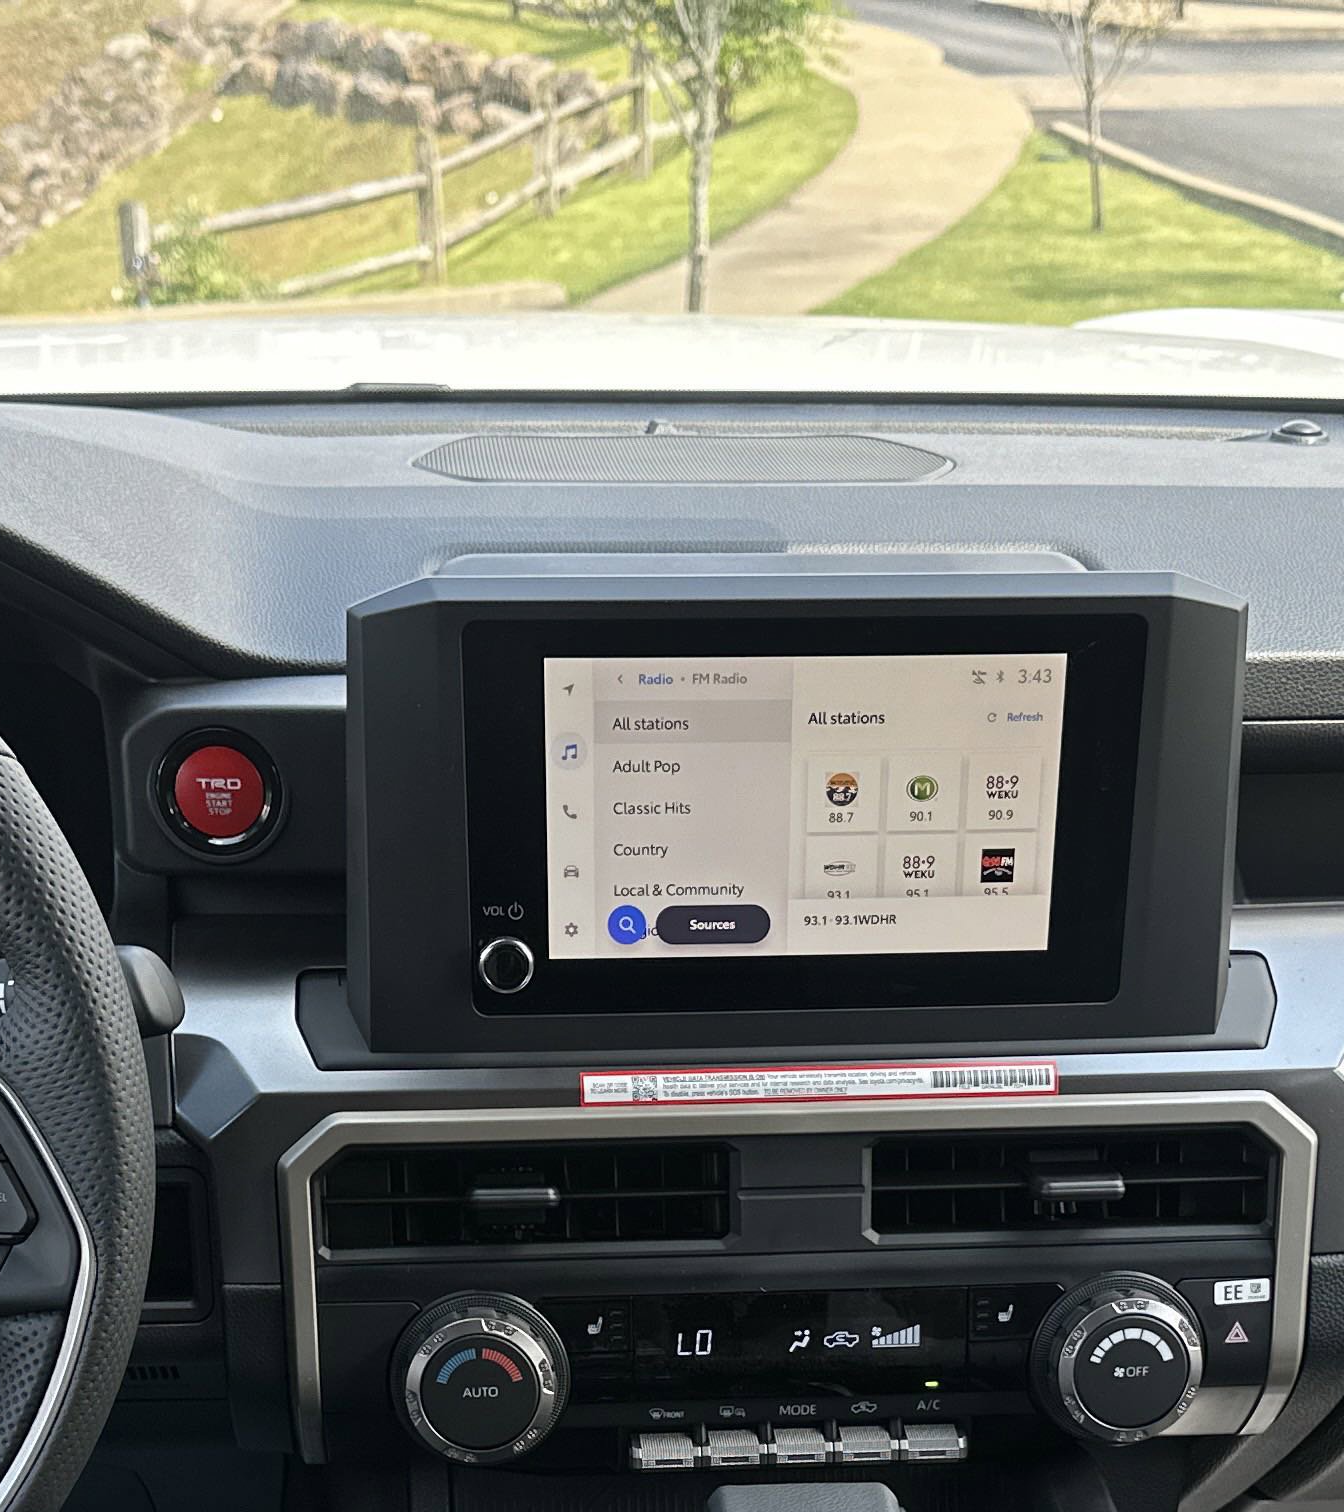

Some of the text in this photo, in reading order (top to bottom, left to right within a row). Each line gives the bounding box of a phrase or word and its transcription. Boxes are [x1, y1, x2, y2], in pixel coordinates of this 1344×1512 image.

[638, 672, 748, 685] Radio FM Radio
[1018, 668, 1053, 684] 3:43
[612, 716, 689, 731] All stations
[807, 711, 885, 725] All stations
[1007, 712, 1044, 723] Refresh
[612, 760, 681, 775] Adult Pop
[196, 778, 241, 790] TRD
[986, 790, 1019, 800] WEKU
[613, 801, 692, 815] Classic Hits
[828, 811, 854, 824] 88.7
[909, 811, 933, 822] 90.1
[988, 810, 1014, 821] 90.9
[613, 843, 668, 859] Country
[902, 869, 936, 879] WEKU
[613, 882, 745, 899] Local & Community
[482, 905, 505, 917] VOL
[689, 919, 736, 931] Sources
[804, 914, 897, 926] 93.1 93.1WDHR
[677, 1330, 713, 1357] LO
[1126, 1365, 1150, 1378] OFF
[463, 1386, 499, 1399] AUTO
[779, 1404, 817, 1416] MODE
[917, 1399, 941, 1411] A/C
